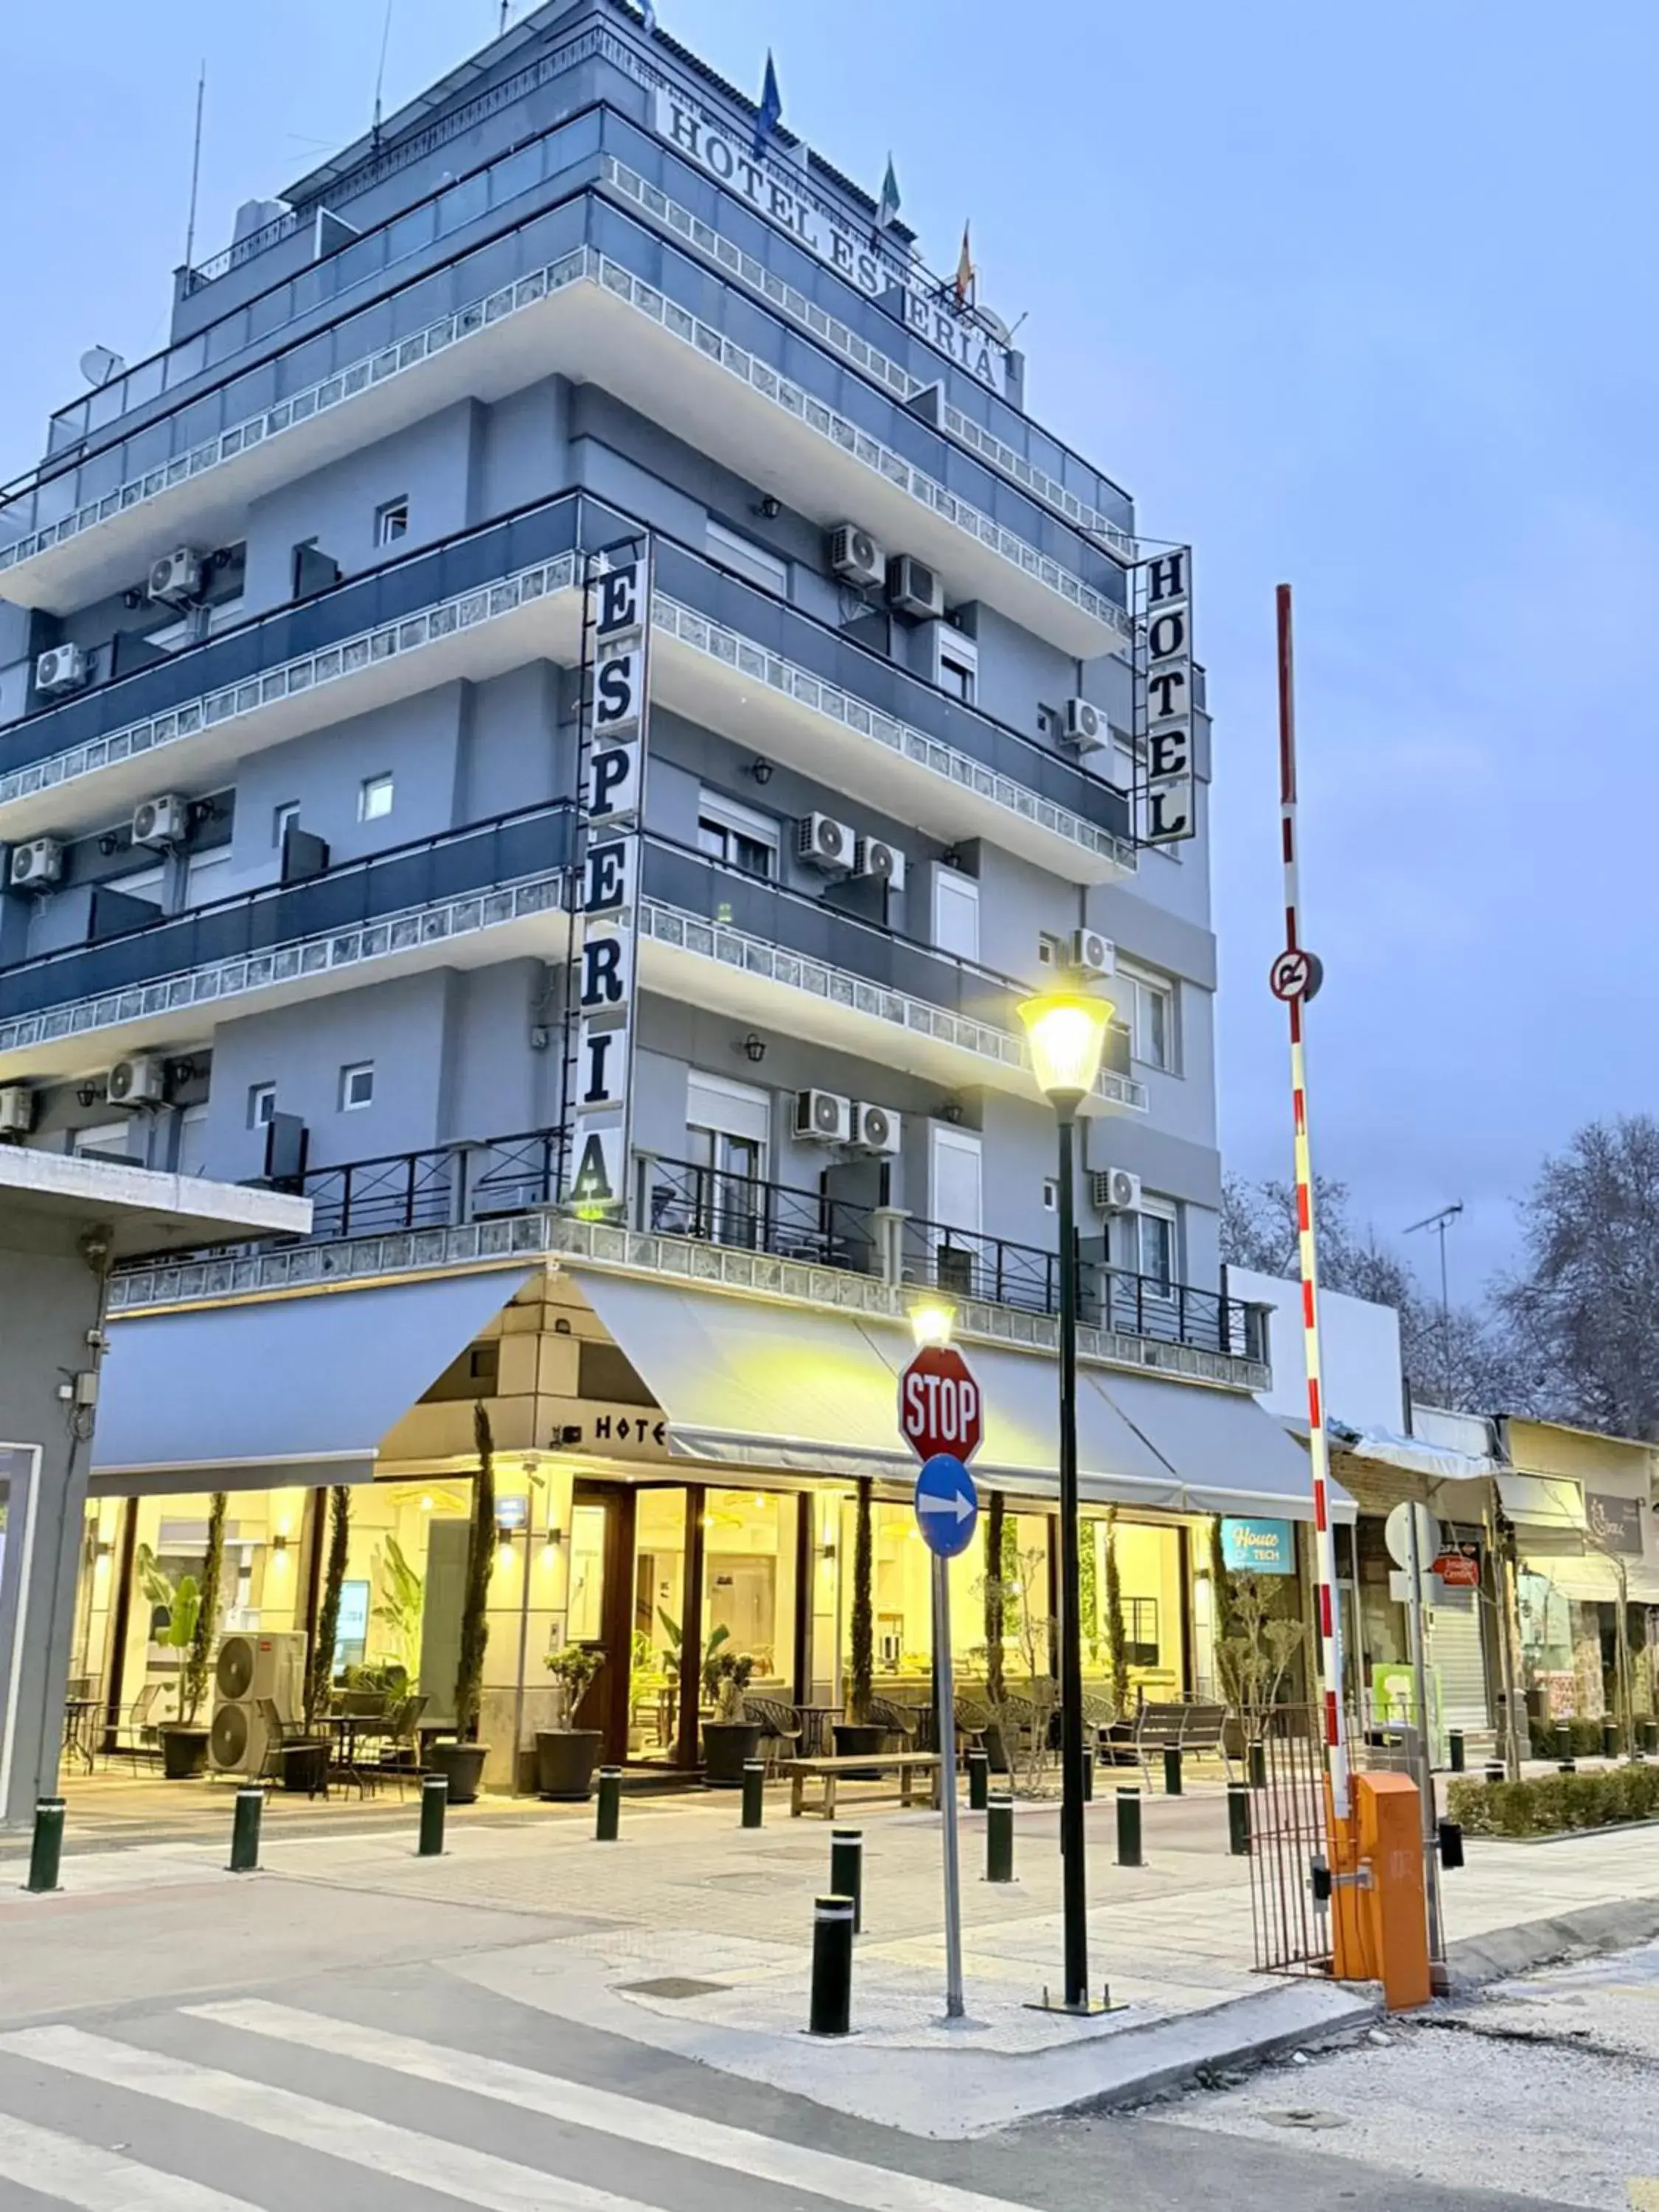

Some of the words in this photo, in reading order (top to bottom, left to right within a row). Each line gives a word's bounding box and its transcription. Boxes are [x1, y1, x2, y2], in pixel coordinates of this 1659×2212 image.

[669, 102, 817, 248] HOTEL
[1148, 553, 1186, 838] HOTEL
[570, 563, 637, 1202] ESPERIA
[906, 1371, 976, 1443] STOP
[1253, 1549, 1281, 1561] TECH
